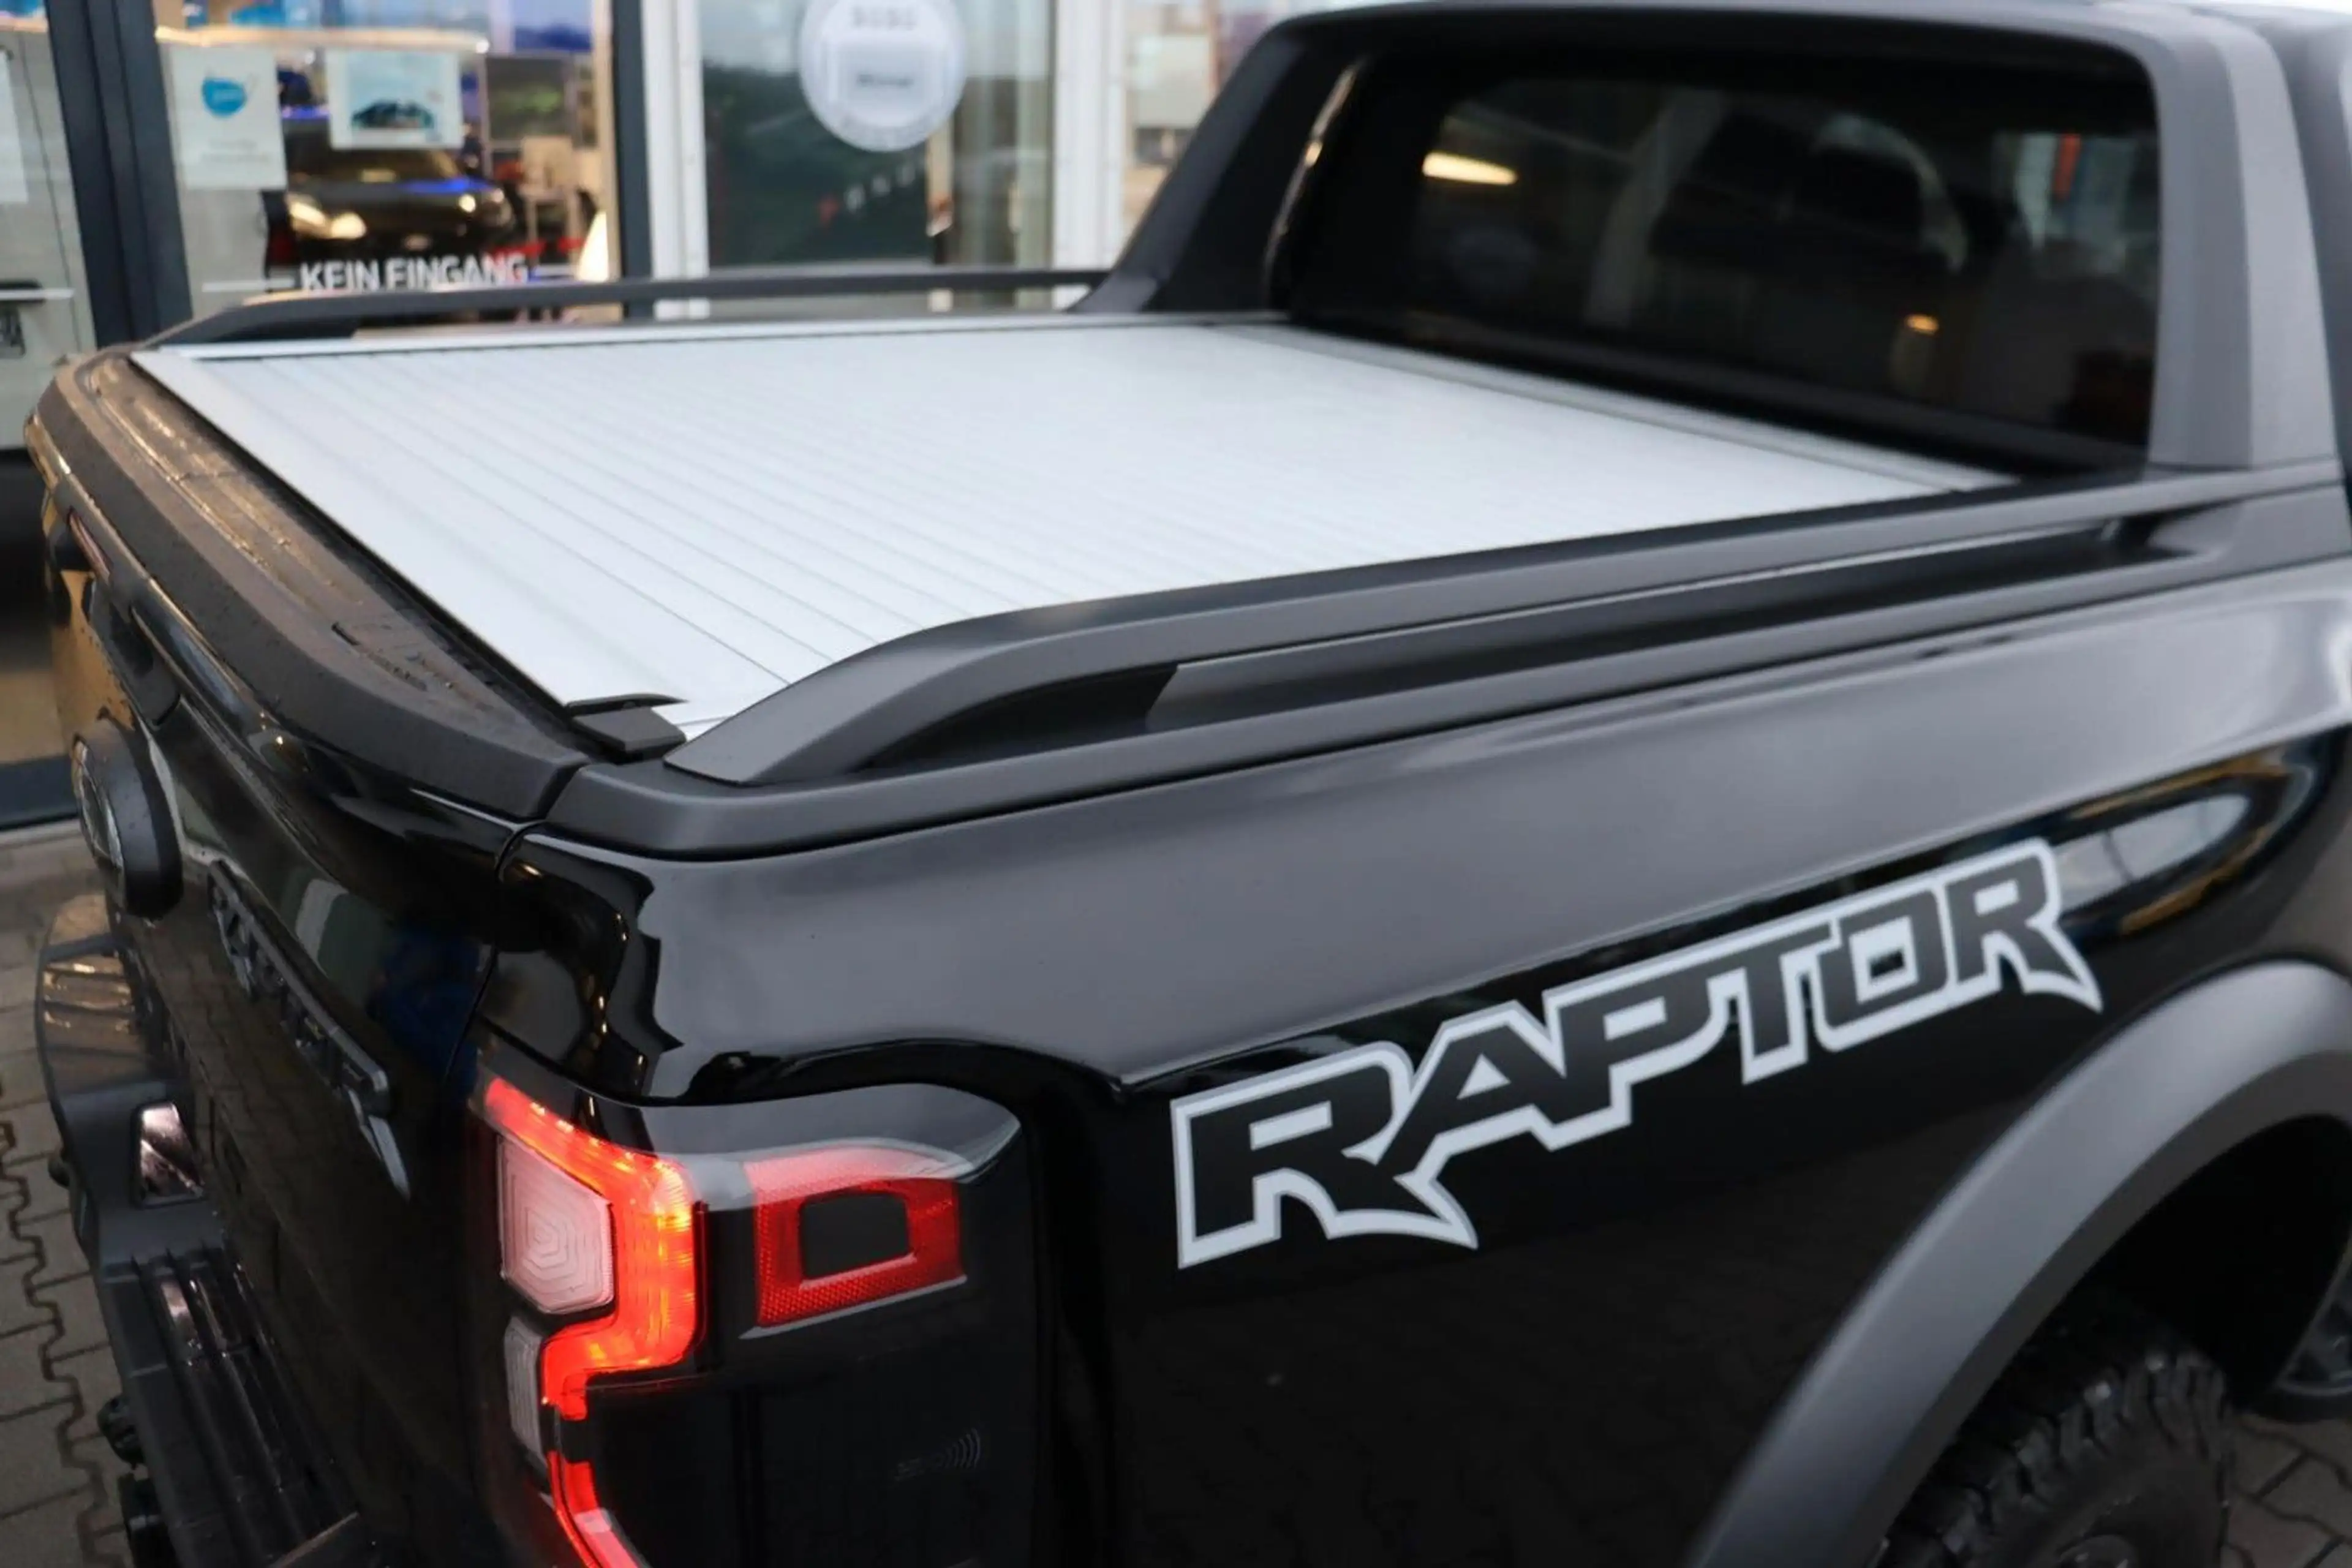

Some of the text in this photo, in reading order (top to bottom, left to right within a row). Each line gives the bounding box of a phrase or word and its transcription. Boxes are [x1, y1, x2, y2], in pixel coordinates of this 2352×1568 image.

[300, 253, 529, 292] KEIN EINGANG
[1169, 837, 2102, 1268] RAPTOR
